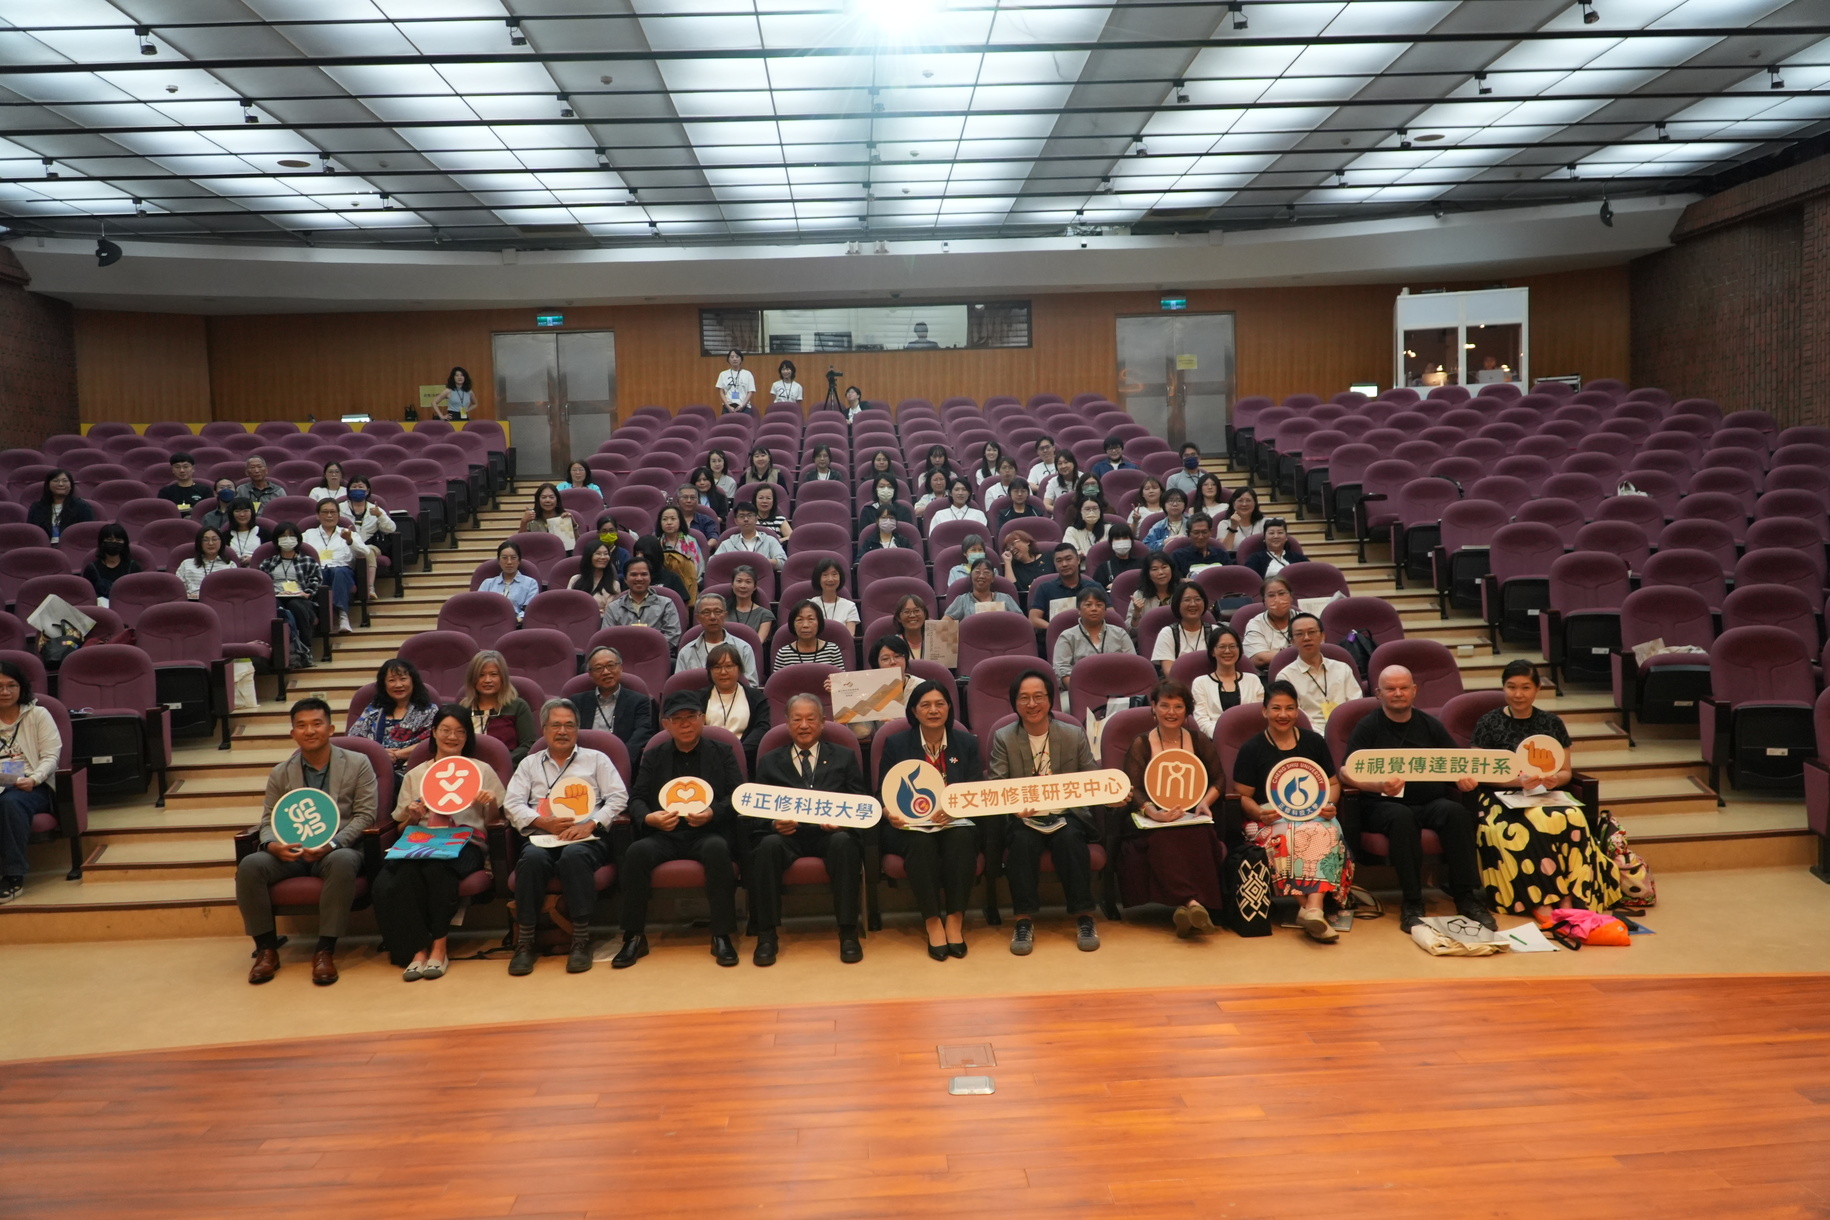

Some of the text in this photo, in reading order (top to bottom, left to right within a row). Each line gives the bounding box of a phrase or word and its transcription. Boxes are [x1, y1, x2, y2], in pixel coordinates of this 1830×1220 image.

[1272, 762, 1325, 784] CHENG SHIU UNIVERSITY
[1354, 756, 1512, 775] #視覺傳達設計系
[948, 776, 1123, 809] #文物修護研究中心
[741, 792, 874, 821] #正修科技大學
